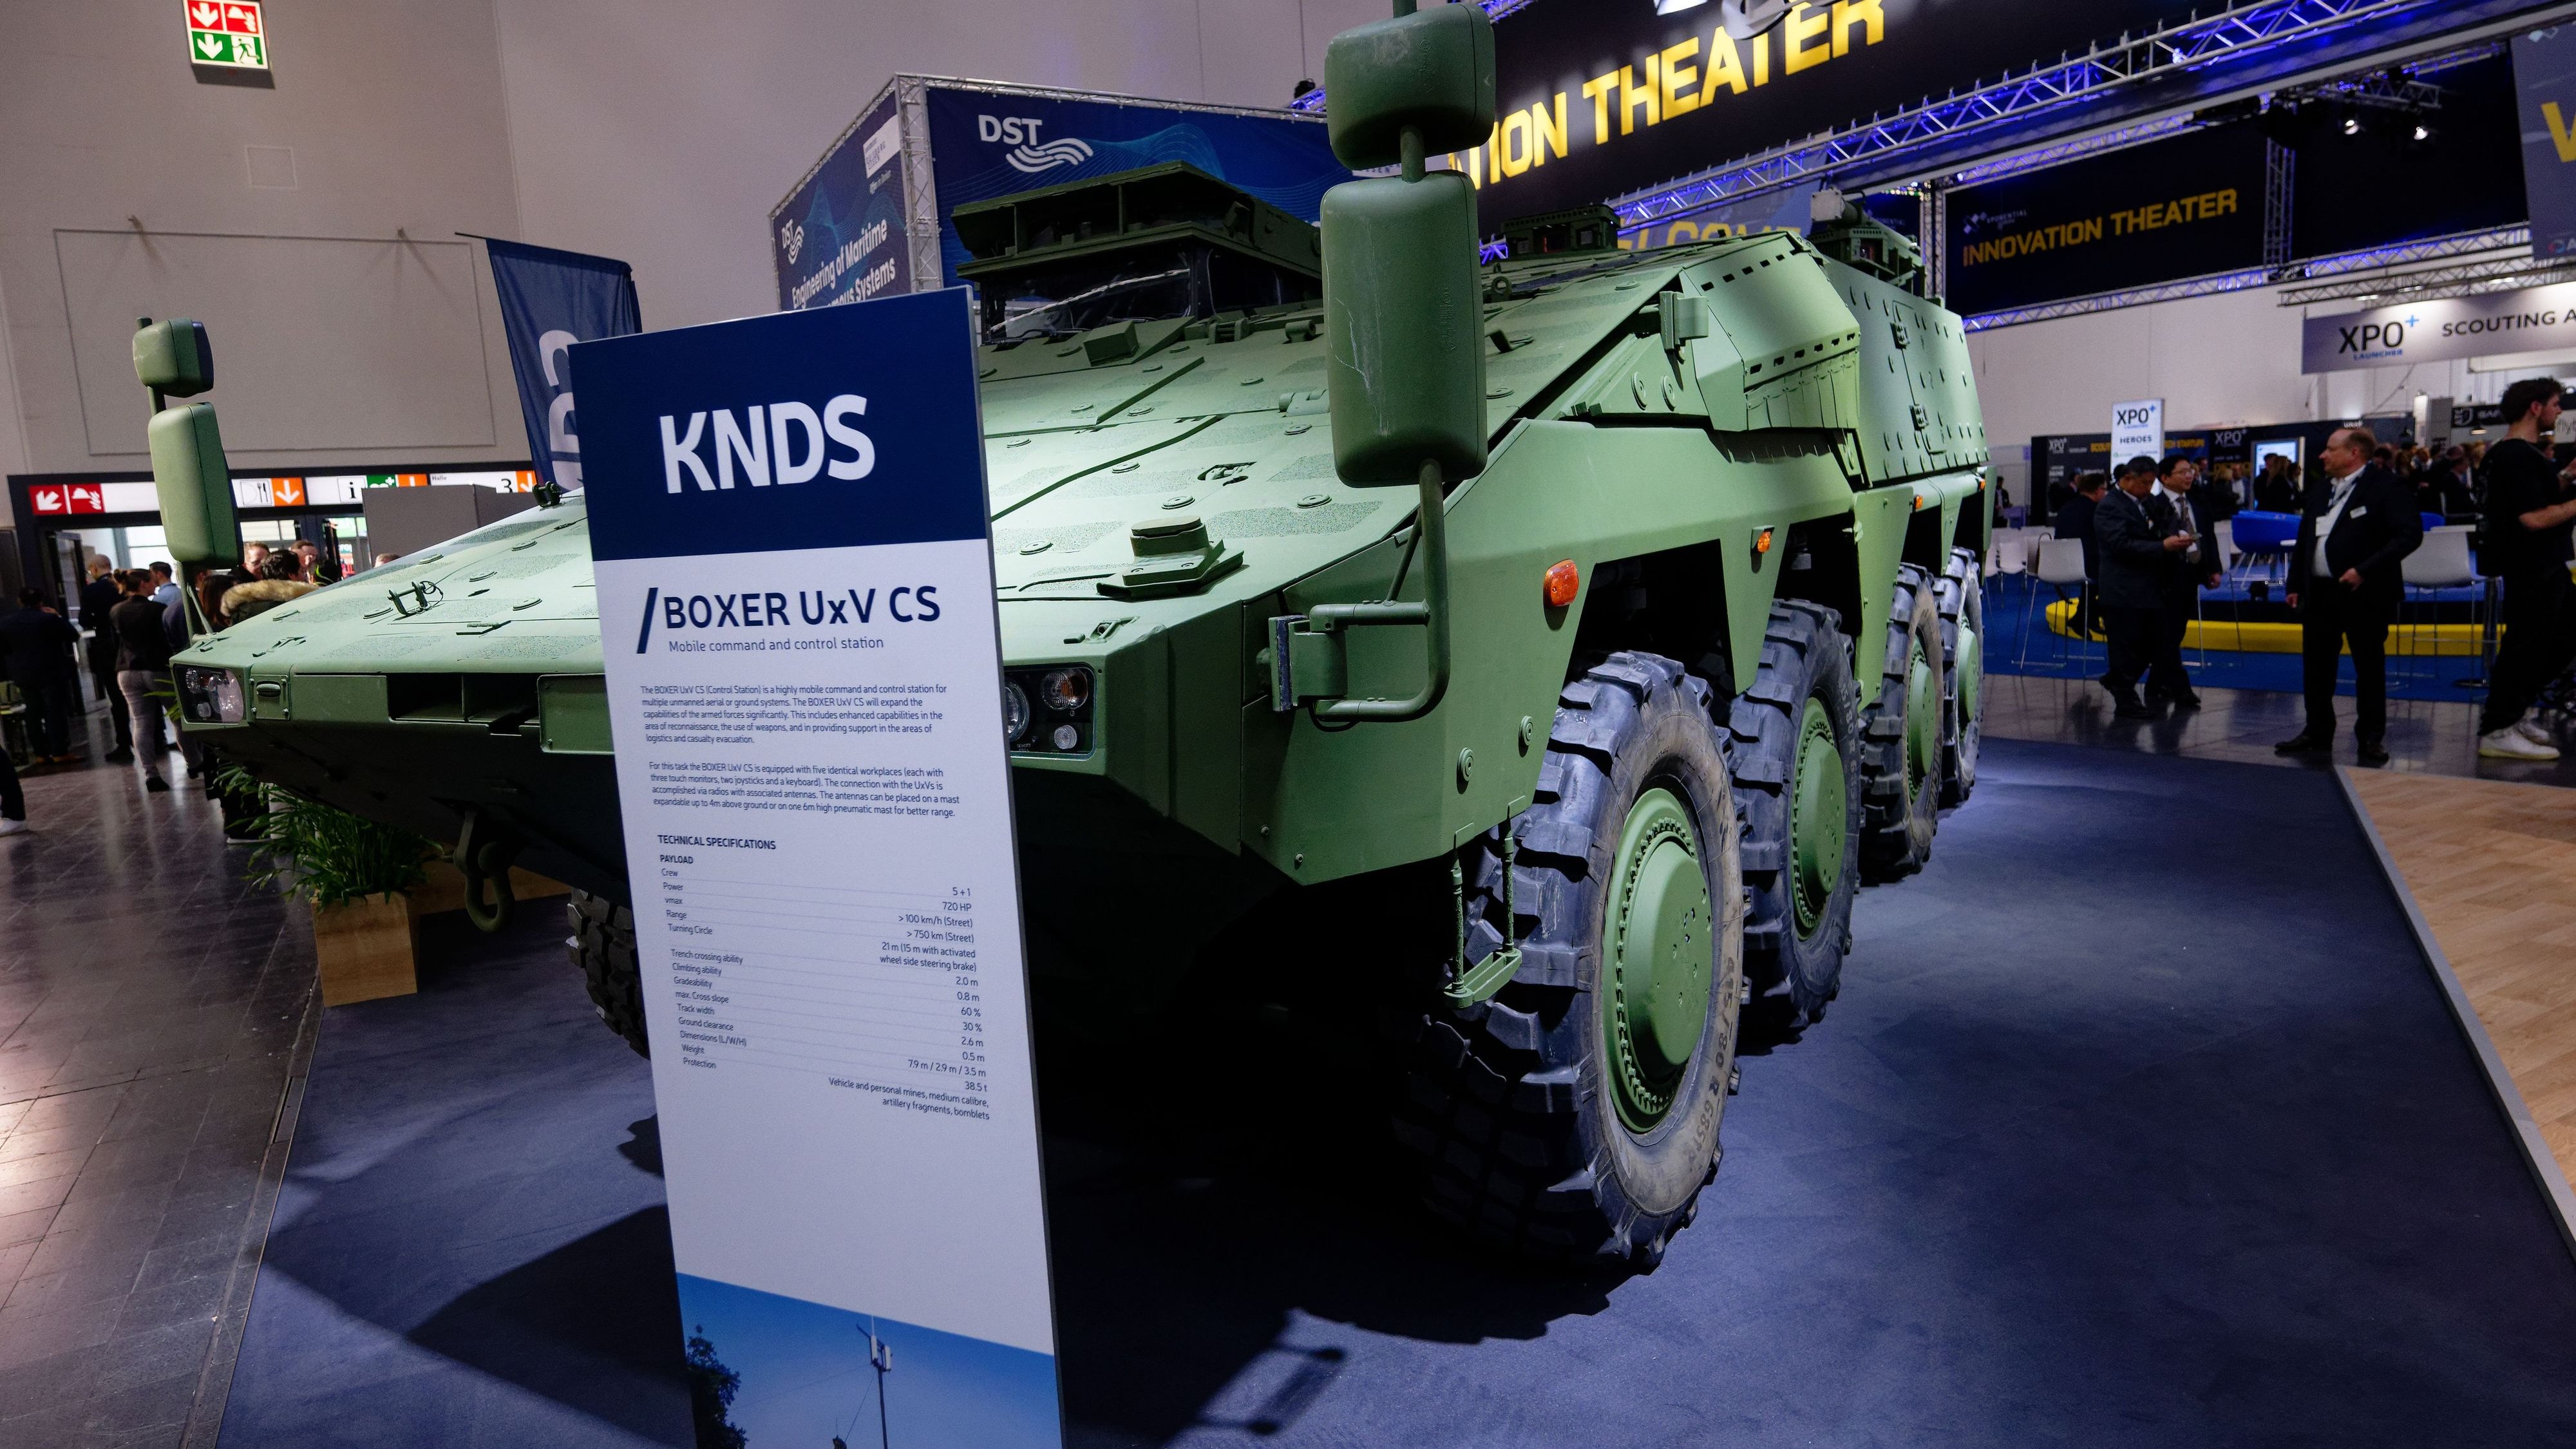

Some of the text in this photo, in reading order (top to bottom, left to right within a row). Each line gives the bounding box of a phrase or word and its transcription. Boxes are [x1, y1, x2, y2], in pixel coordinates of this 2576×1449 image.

[978, 114, 1043, 146] DST
[781, 219, 793, 250] DST
[1963, 188, 2238, 268] INNOVATION THEATER
[791, 218, 888, 309] Engineering of Maritime
[855, 256, 896, 301] Systems
[2441, 311, 2555, 337] SCOUTING
[2353, 348, 2403, 361] LAUNCHER
[659, 394, 876, 494] KNDS
[2119, 435, 2153, 444] HEROES
[800, 589, 876, 625] UxV
[889, 585, 941, 623] CS
[668, 636, 884, 653] Mobile command and control station
[640, 686, 654, 694] The
[654, 686, 679, 694] BOXER
[679, 686, 694, 694] UxV
[775, 685, 798, 696] highly
[799, 685, 824, 694] mobile
[863, 685, 878, 693] and
[878, 685, 906, 693] control
[935, 684, 947, 693] for
[641, 698, 668, 706] multiple
[705, 698, 724, 706] aerial
[734, 698, 759, 706] ground
[793, 697, 807, 706] The
[808, 697, 835, 706] BOXER
[836, 698, 852, 706] UxV
[853, 697, 864, 706] CS
[866, 697, 879, 706] will
[880, 698, 909, 708] expand
[910, 697, 923, 706] the
[643, 710, 680, 718] capabilities
[680, 710, 688, 718] of
[790, 710, 806, 719] This
[807, 710, 838, 719] includes
[838, 711, 875, 719] enhanced
[876, 711, 920, 720] capabilities
[929, 711, 943, 719] the
[658, 835, 777, 850] TECHNICAL SPECIFICATIONS
[659, 855, 694, 864] PAYLOAD
[661, 868, 678, 876] Crew
[663, 882, 683, 891] Power
[952, 887, 958, 896] 5
[967, 888, 971, 896] 1
[942, 902, 972, 911] 720 HP
[666, 909, 687, 921] Range
[905, 914, 920, 923] 100
[920, 915, 942, 925] km/h
[943, 916, 973, 928] (Street)
[668, 923, 713, 935] Turning Circle
[914, 929, 930, 940] 750
[931, 931, 943, 940] km
[945, 932, 974, 943] (Street)
[882, 942, 890, 951] 21
[900, 943, 911, 953] (15
[922, 945, 939, 955] with
[940, 947, 976, 958] activated
[671, 949, 743, 965] Trench crossing ability
[880, 954, 977, 972] wheel side steering brake)
[672, 962, 722, 977] Climbing ability
[674, 976, 712, 989] Gradeability
[956, 976, 969, 986] 2.0
[692, 991, 711, 1001] Cross
[711, 994, 729, 1005] slope
[957, 991, 970, 1001] 0.8
[677, 1003, 715, 1015] Track width
[961, 1007, 981, 1017] 60 %
[678, 1017, 734, 1031] Ground clearance
[963, 1021, 982, 1032] 30 %
[679, 1030, 747, 1046] Dimensions (L/W/H)
[961, 1036, 974, 1046] 2.6
[681, 1044, 705, 1056] Weight
[962, 1051, 976, 1061] 0.5
[683, 1057, 717, 1069] Protection
[936, 1063, 947, 1072] 2.9
[964, 1066, 976, 1076] 3.5
[828, 1077, 989, 1108] Vehicle and personal mines, medium calibre,
[965, 1081, 983, 1092] 38.5
[882, 1097, 990, 1120] artillery fragments, bomblets
